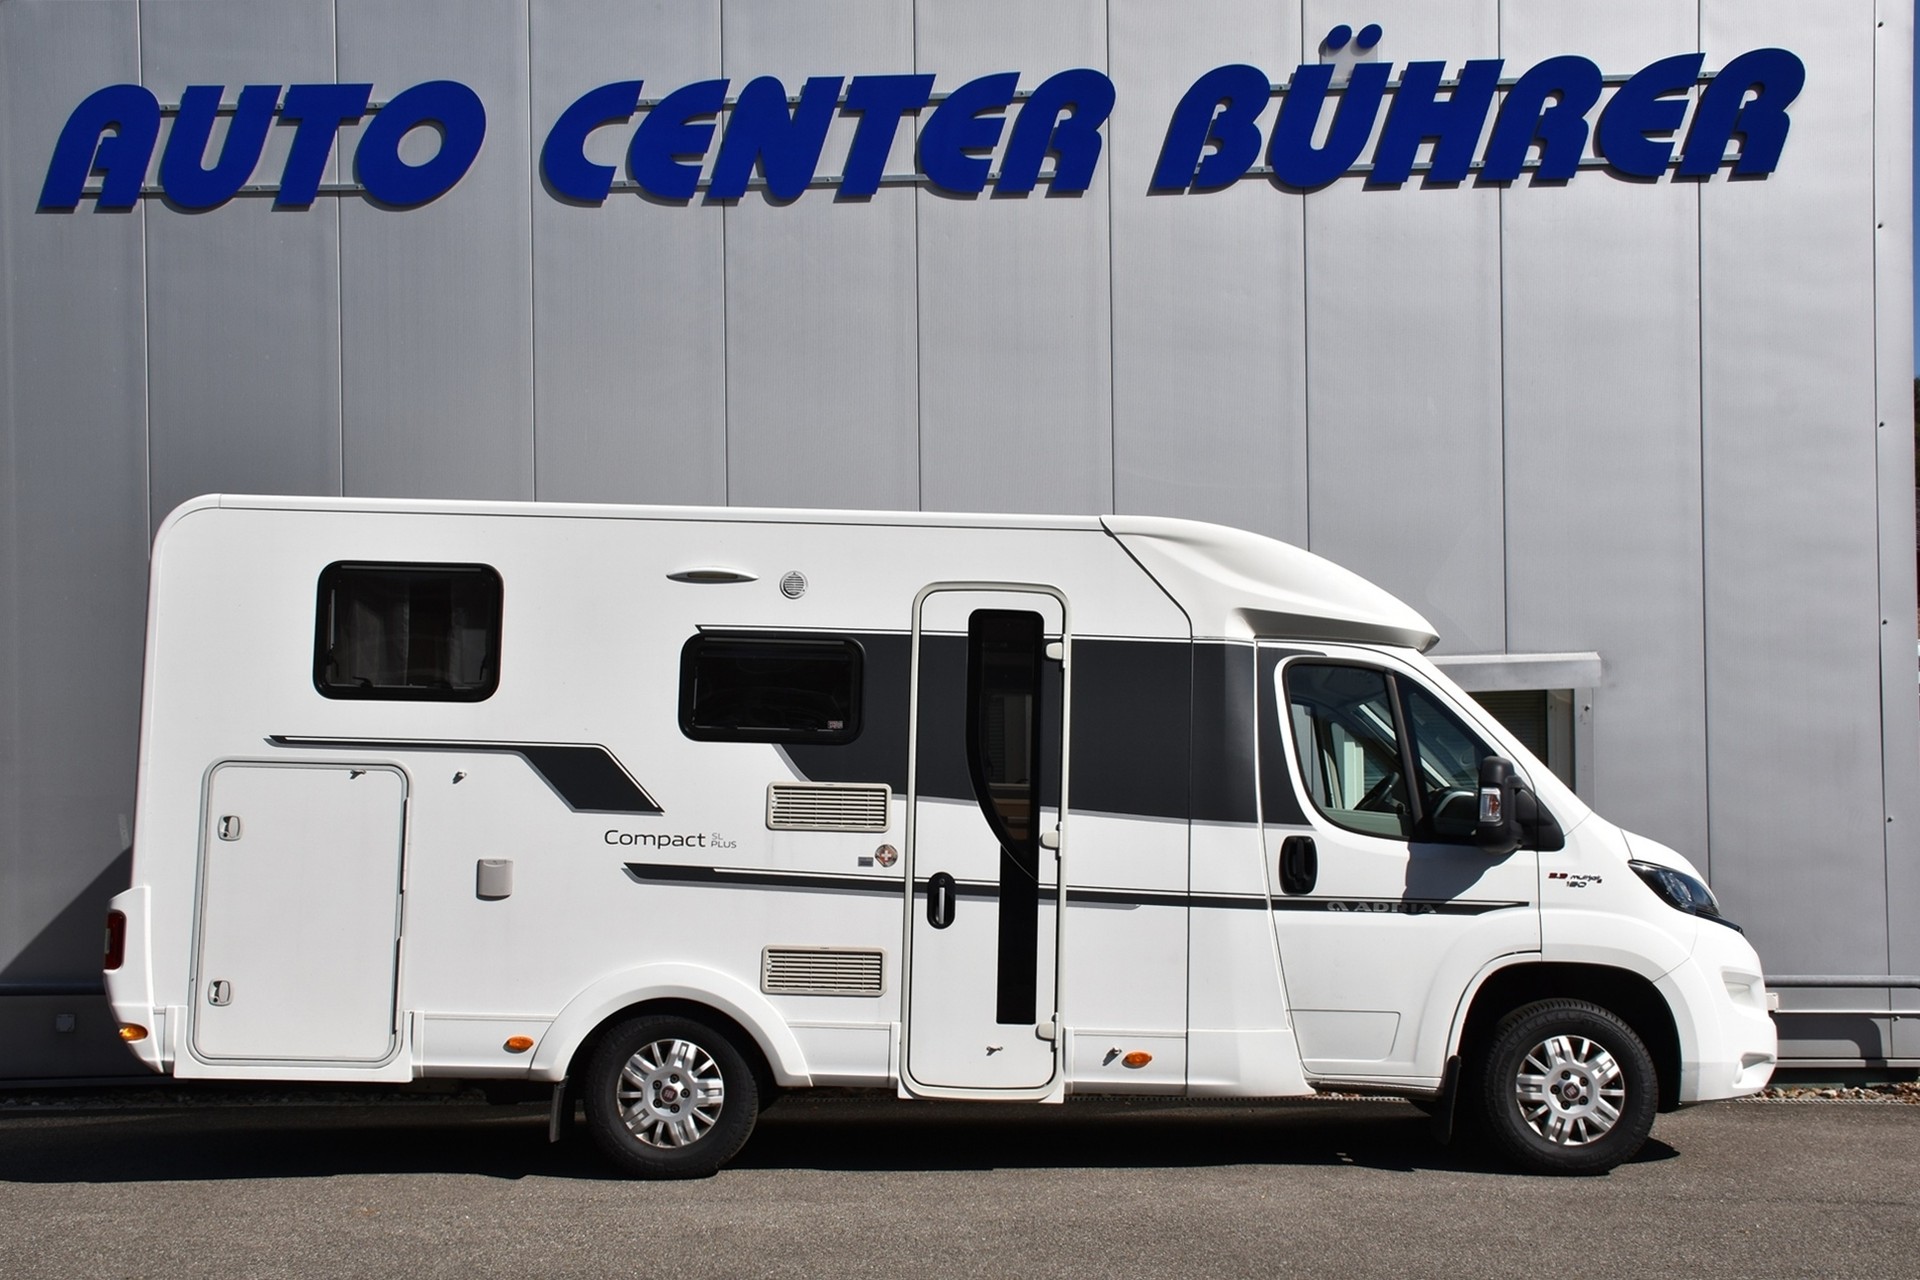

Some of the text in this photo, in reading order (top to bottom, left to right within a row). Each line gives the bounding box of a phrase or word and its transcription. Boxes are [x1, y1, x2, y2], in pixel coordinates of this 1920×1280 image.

[42, 26, 1803, 206] AUTO CENTER BÜHRER
[604, 829, 706, 850] Compact
[711, 832, 723, 840] SL
[710, 840, 737, 849] PLUS
[1353, 901, 1437, 914] ADRIA
